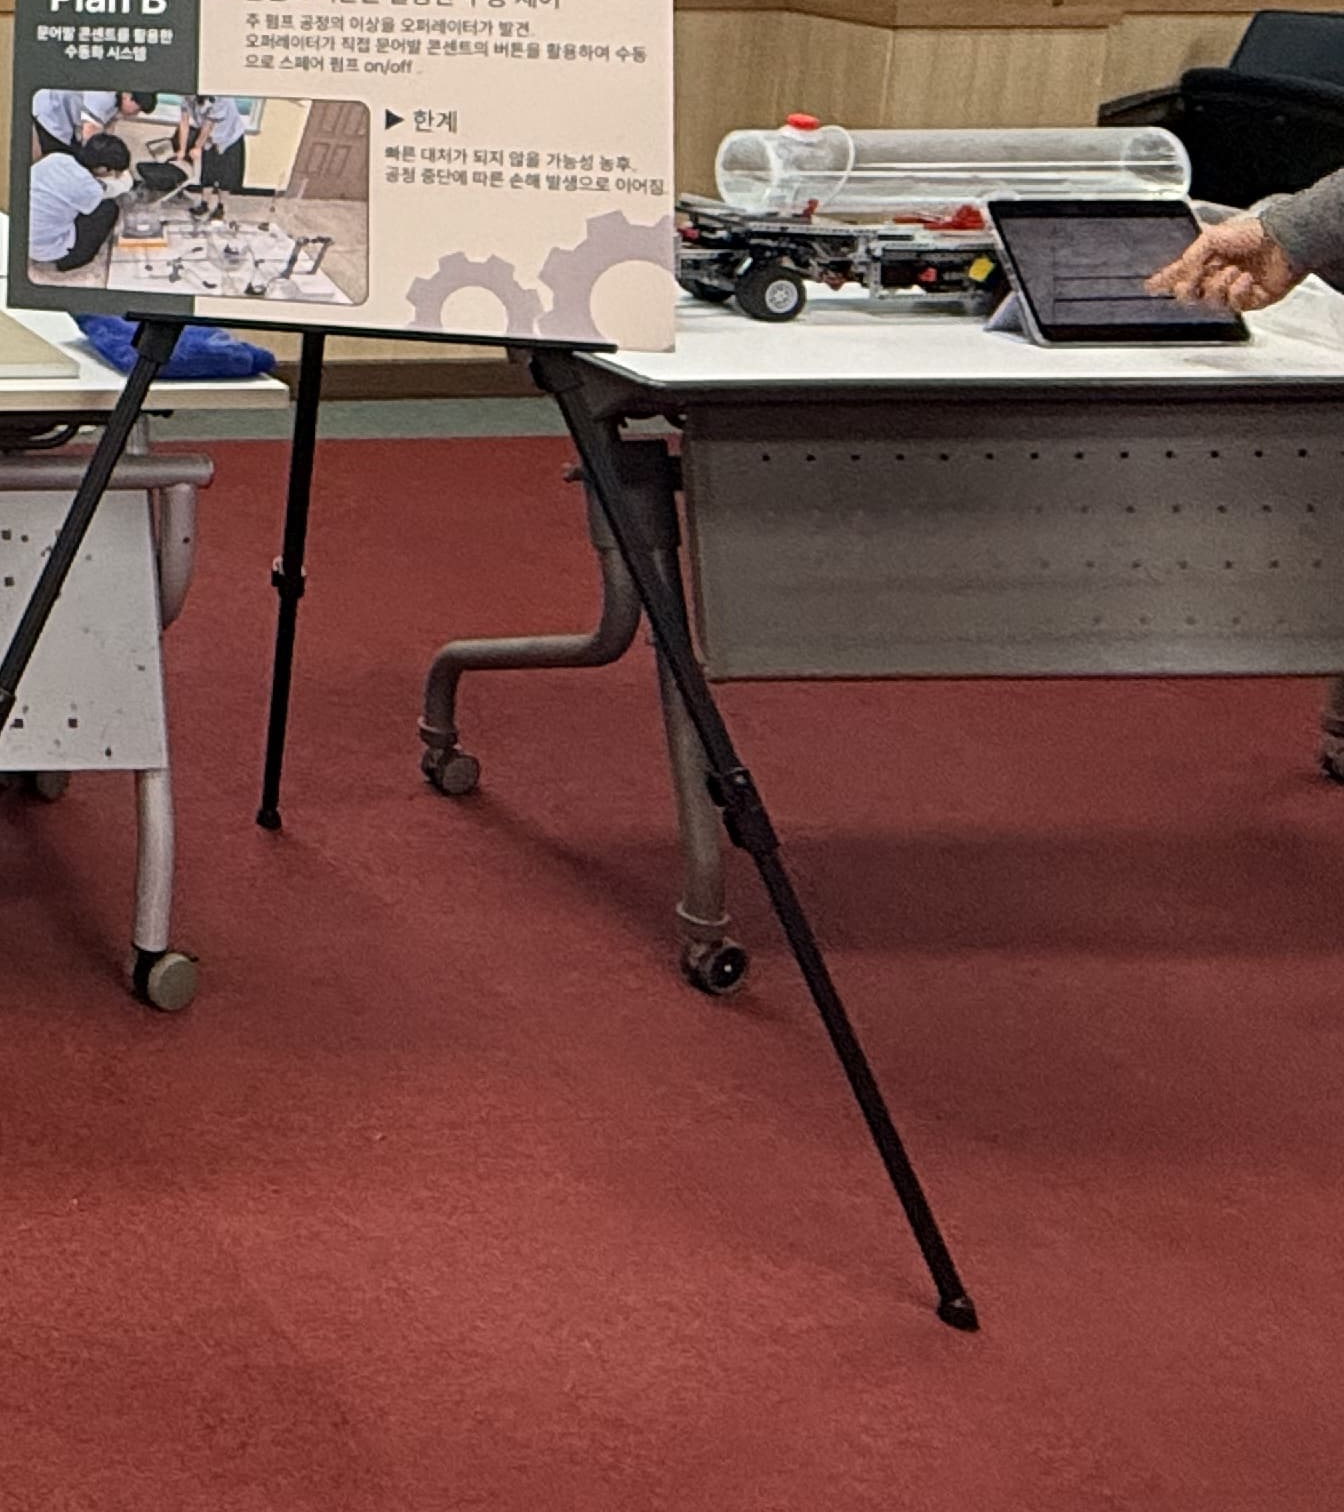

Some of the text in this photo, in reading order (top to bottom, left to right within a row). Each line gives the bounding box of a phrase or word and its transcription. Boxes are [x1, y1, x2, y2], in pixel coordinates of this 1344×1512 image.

[37, 25, 76, 41] 문어발
[78, 26, 130, 43] 콘센트를
[246, 13, 535, 38] 주 펌프 공정의 이상을 오퍼레이터가 발견.
[106, 45, 147, 62] 시스템
[246, 33, 648, 64] 오퍼레이터가 직접 문어발 콘센트의 버튼을 활용하여 수동
[243, 54, 275, 70] 으로
[278, 55, 325, 72] 스페어
[329, 57, 360, 73] 펌프
[413, 108, 458, 134] 한계
[384, 144, 416, 163] 빠른
[420, 147, 468, 165] 대처가
[473, 148, 505, 167] 되지
[509, 150, 540, 169] 않을
[545, 152, 594, 171] 가능성
[384, 166, 416, 184] 공정
[420, 168, 468, 186] 중단에
[472, 169, 505, 188] 따른
[509, 171, 541, 190] 손해
[545, 173, 611, 193] 발생으로
